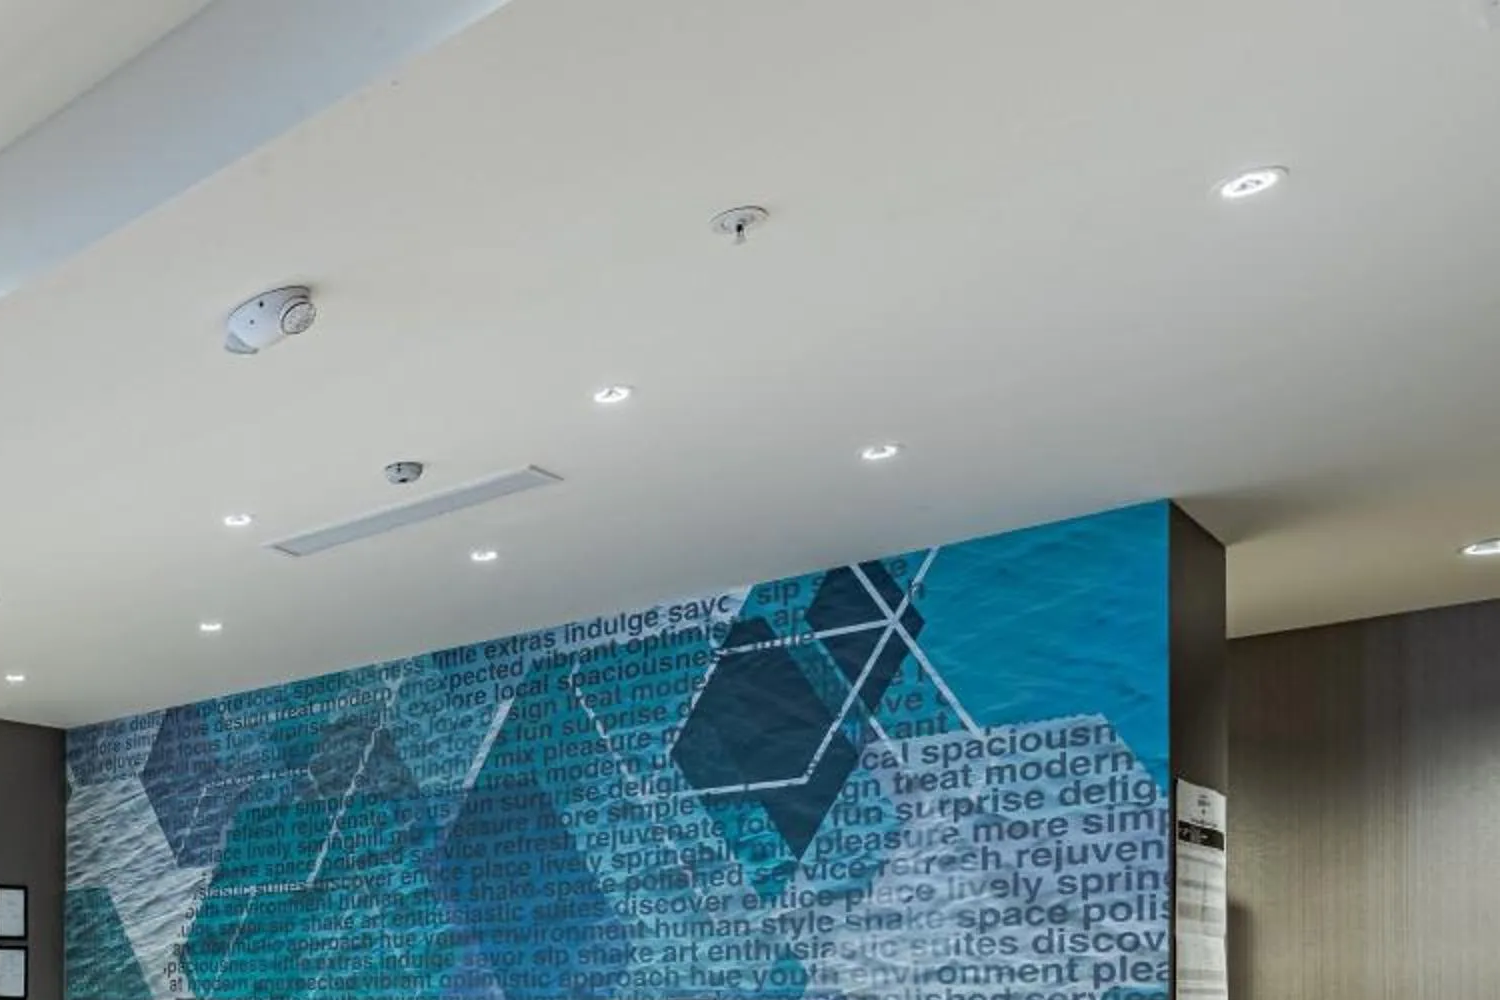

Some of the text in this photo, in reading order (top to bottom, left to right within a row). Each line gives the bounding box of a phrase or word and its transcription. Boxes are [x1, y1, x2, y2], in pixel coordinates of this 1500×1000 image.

[484, 629, 556, 659] extras
[564, 608, 658, 643] indulge
[532, 637, 617, 672] vibrant
[495, 672, 547, 701] local
[479, 698, 557, 726] dsign
[516, 721, 553, 742] fun
[544, 729, 651, 765] pleasure
[546, 755, 640, 783] modern
[538, 807, 598, 829] more
[608, 794, 694, 823] simple
[894, 763, 972, 793] treat
[985, 749, 1134, 784] modern
[586, 817, 725, 850] rejuvenate
[830, 802, 882, 826] fun
[895, 786, 1045, 822] surprise
[539, 850, 603, 875] lively
[814, 824, 960, 859] pleasure
[973, 815, 1069, 842] more
[614, 893, 734, 915] discover
[742, 884, 833, 909] entice
[952, 870, 1044, 902] lively
[626, 862, 742, 896] polished
[655, 916, 750, 937] human
[761, 909, 834, 938] style
[957, 903, 1068, 932] space
[576, 941, 654, 963] shake
[660, 941, 700, 961] art
[910, 930, 1019, 956] suites
[558, 964, 680, 992] approach
[690, 963, 742, 985] hue
[850, 958, 1080, 983] environment
